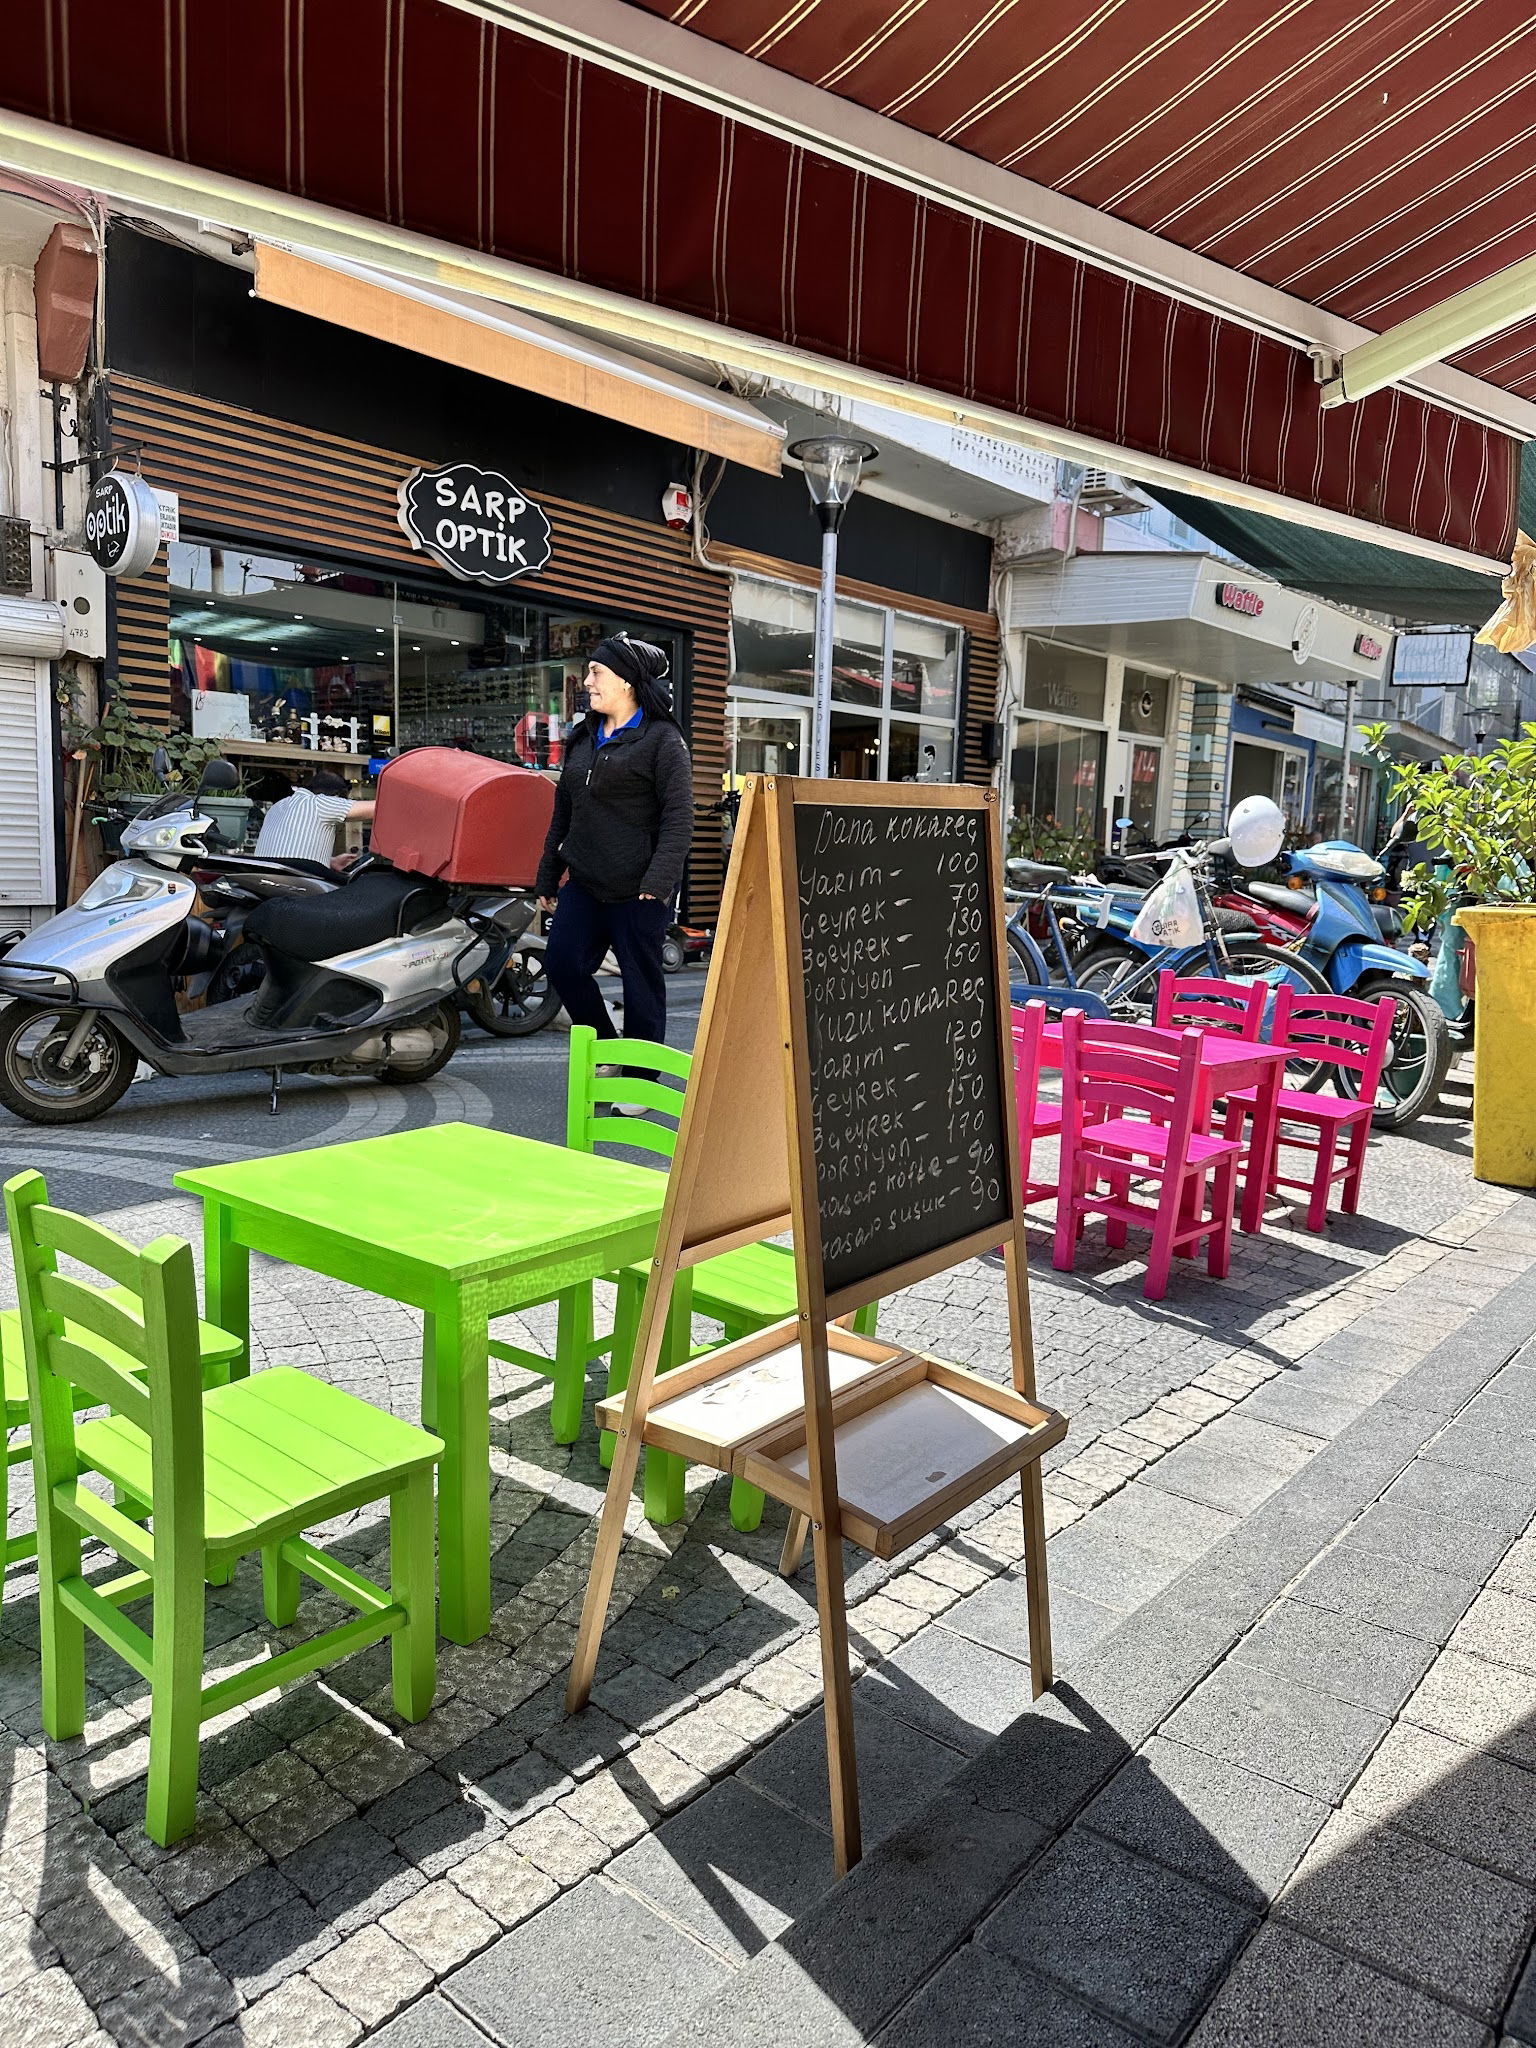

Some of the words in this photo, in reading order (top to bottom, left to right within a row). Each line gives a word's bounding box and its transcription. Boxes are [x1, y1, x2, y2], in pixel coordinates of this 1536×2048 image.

[95, 484, 112, 498] SARP
[435, 477, 526, 524] SARP
[86, 492, 127, 550] optik
[435, 518, 528, 566] OPTİK
[1221, 583, 1264, 616] Waffle
[937, 851, 979, 875] 100
[949, 882, 979, 909] 70
[946, 906, 982, 938] 130
[944, 941, 981, 971] 150
[945, 1020, 982, 1044] 120
[947, 1073, 984, 1108] 150
[947, 1109, 985, 1143] 170
[968, 1138, 995, 1175] 90
[970, 1175, 1000, 1211] 90
